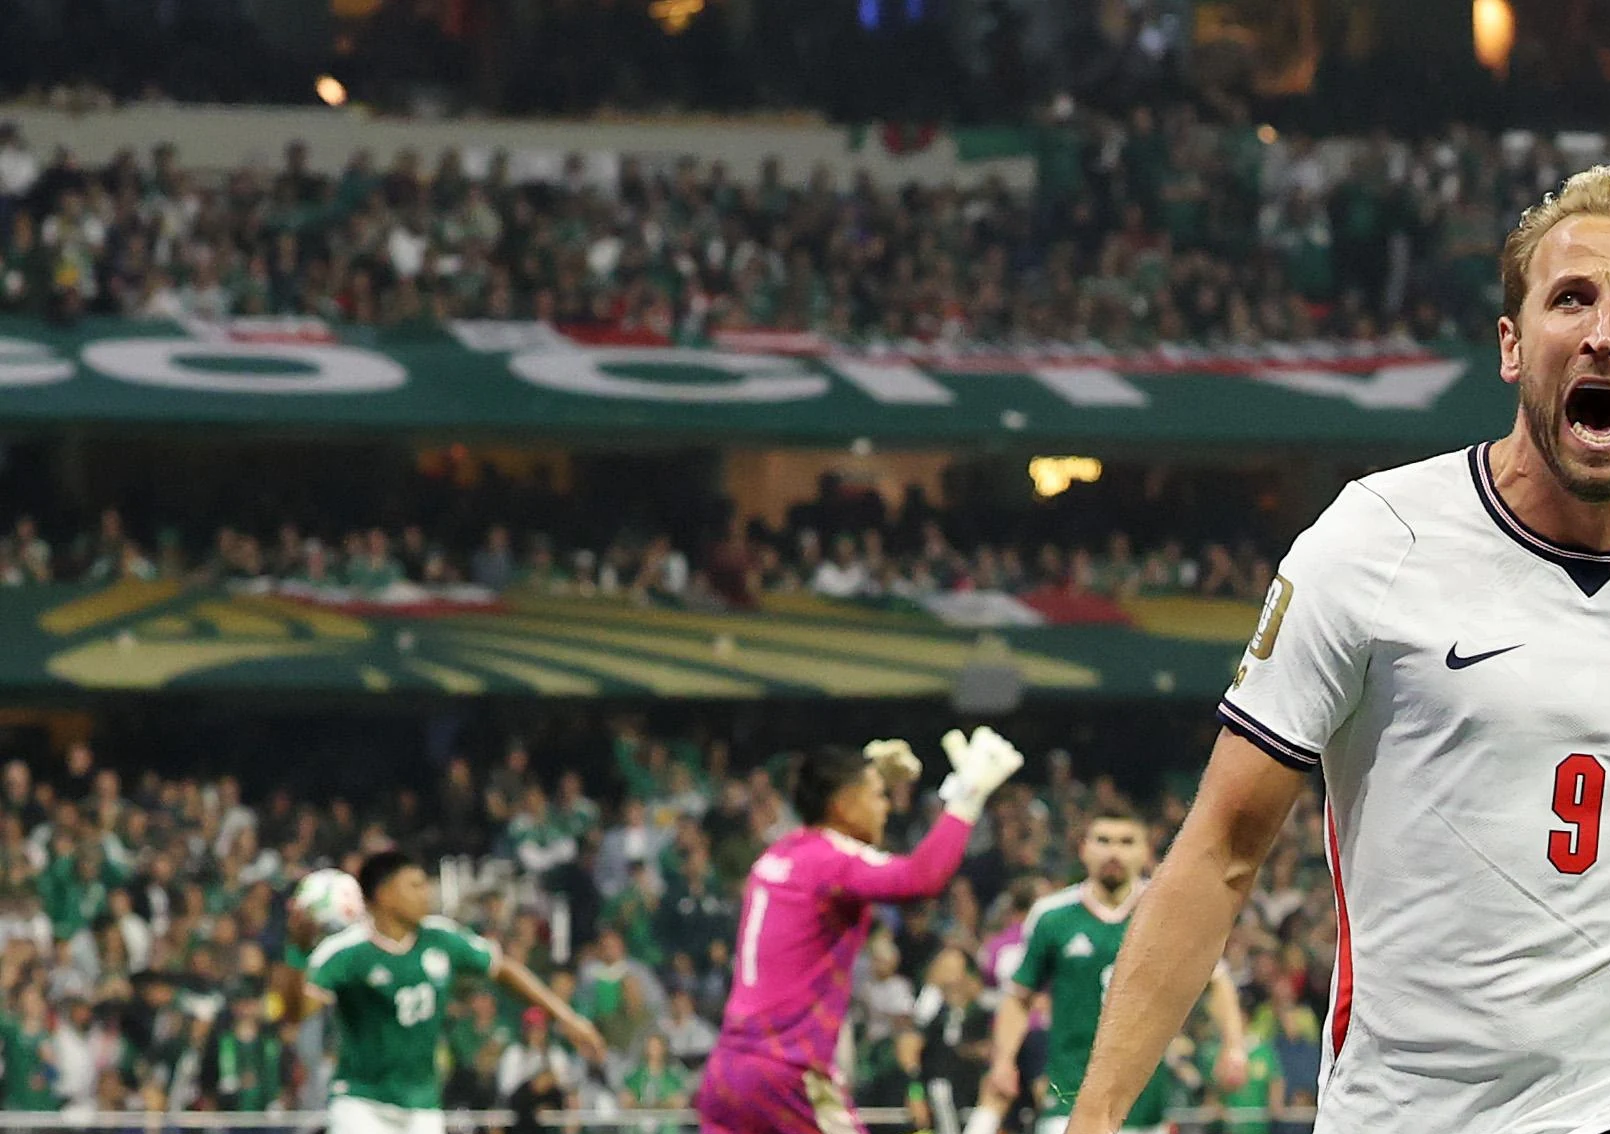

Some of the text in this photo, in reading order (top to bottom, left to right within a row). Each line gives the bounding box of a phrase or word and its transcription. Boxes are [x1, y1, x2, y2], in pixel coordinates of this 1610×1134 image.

[0, 336, 406, 393] O
[1547, 753, 1606, 875] 9
[742, 885, 768, 987] 1
